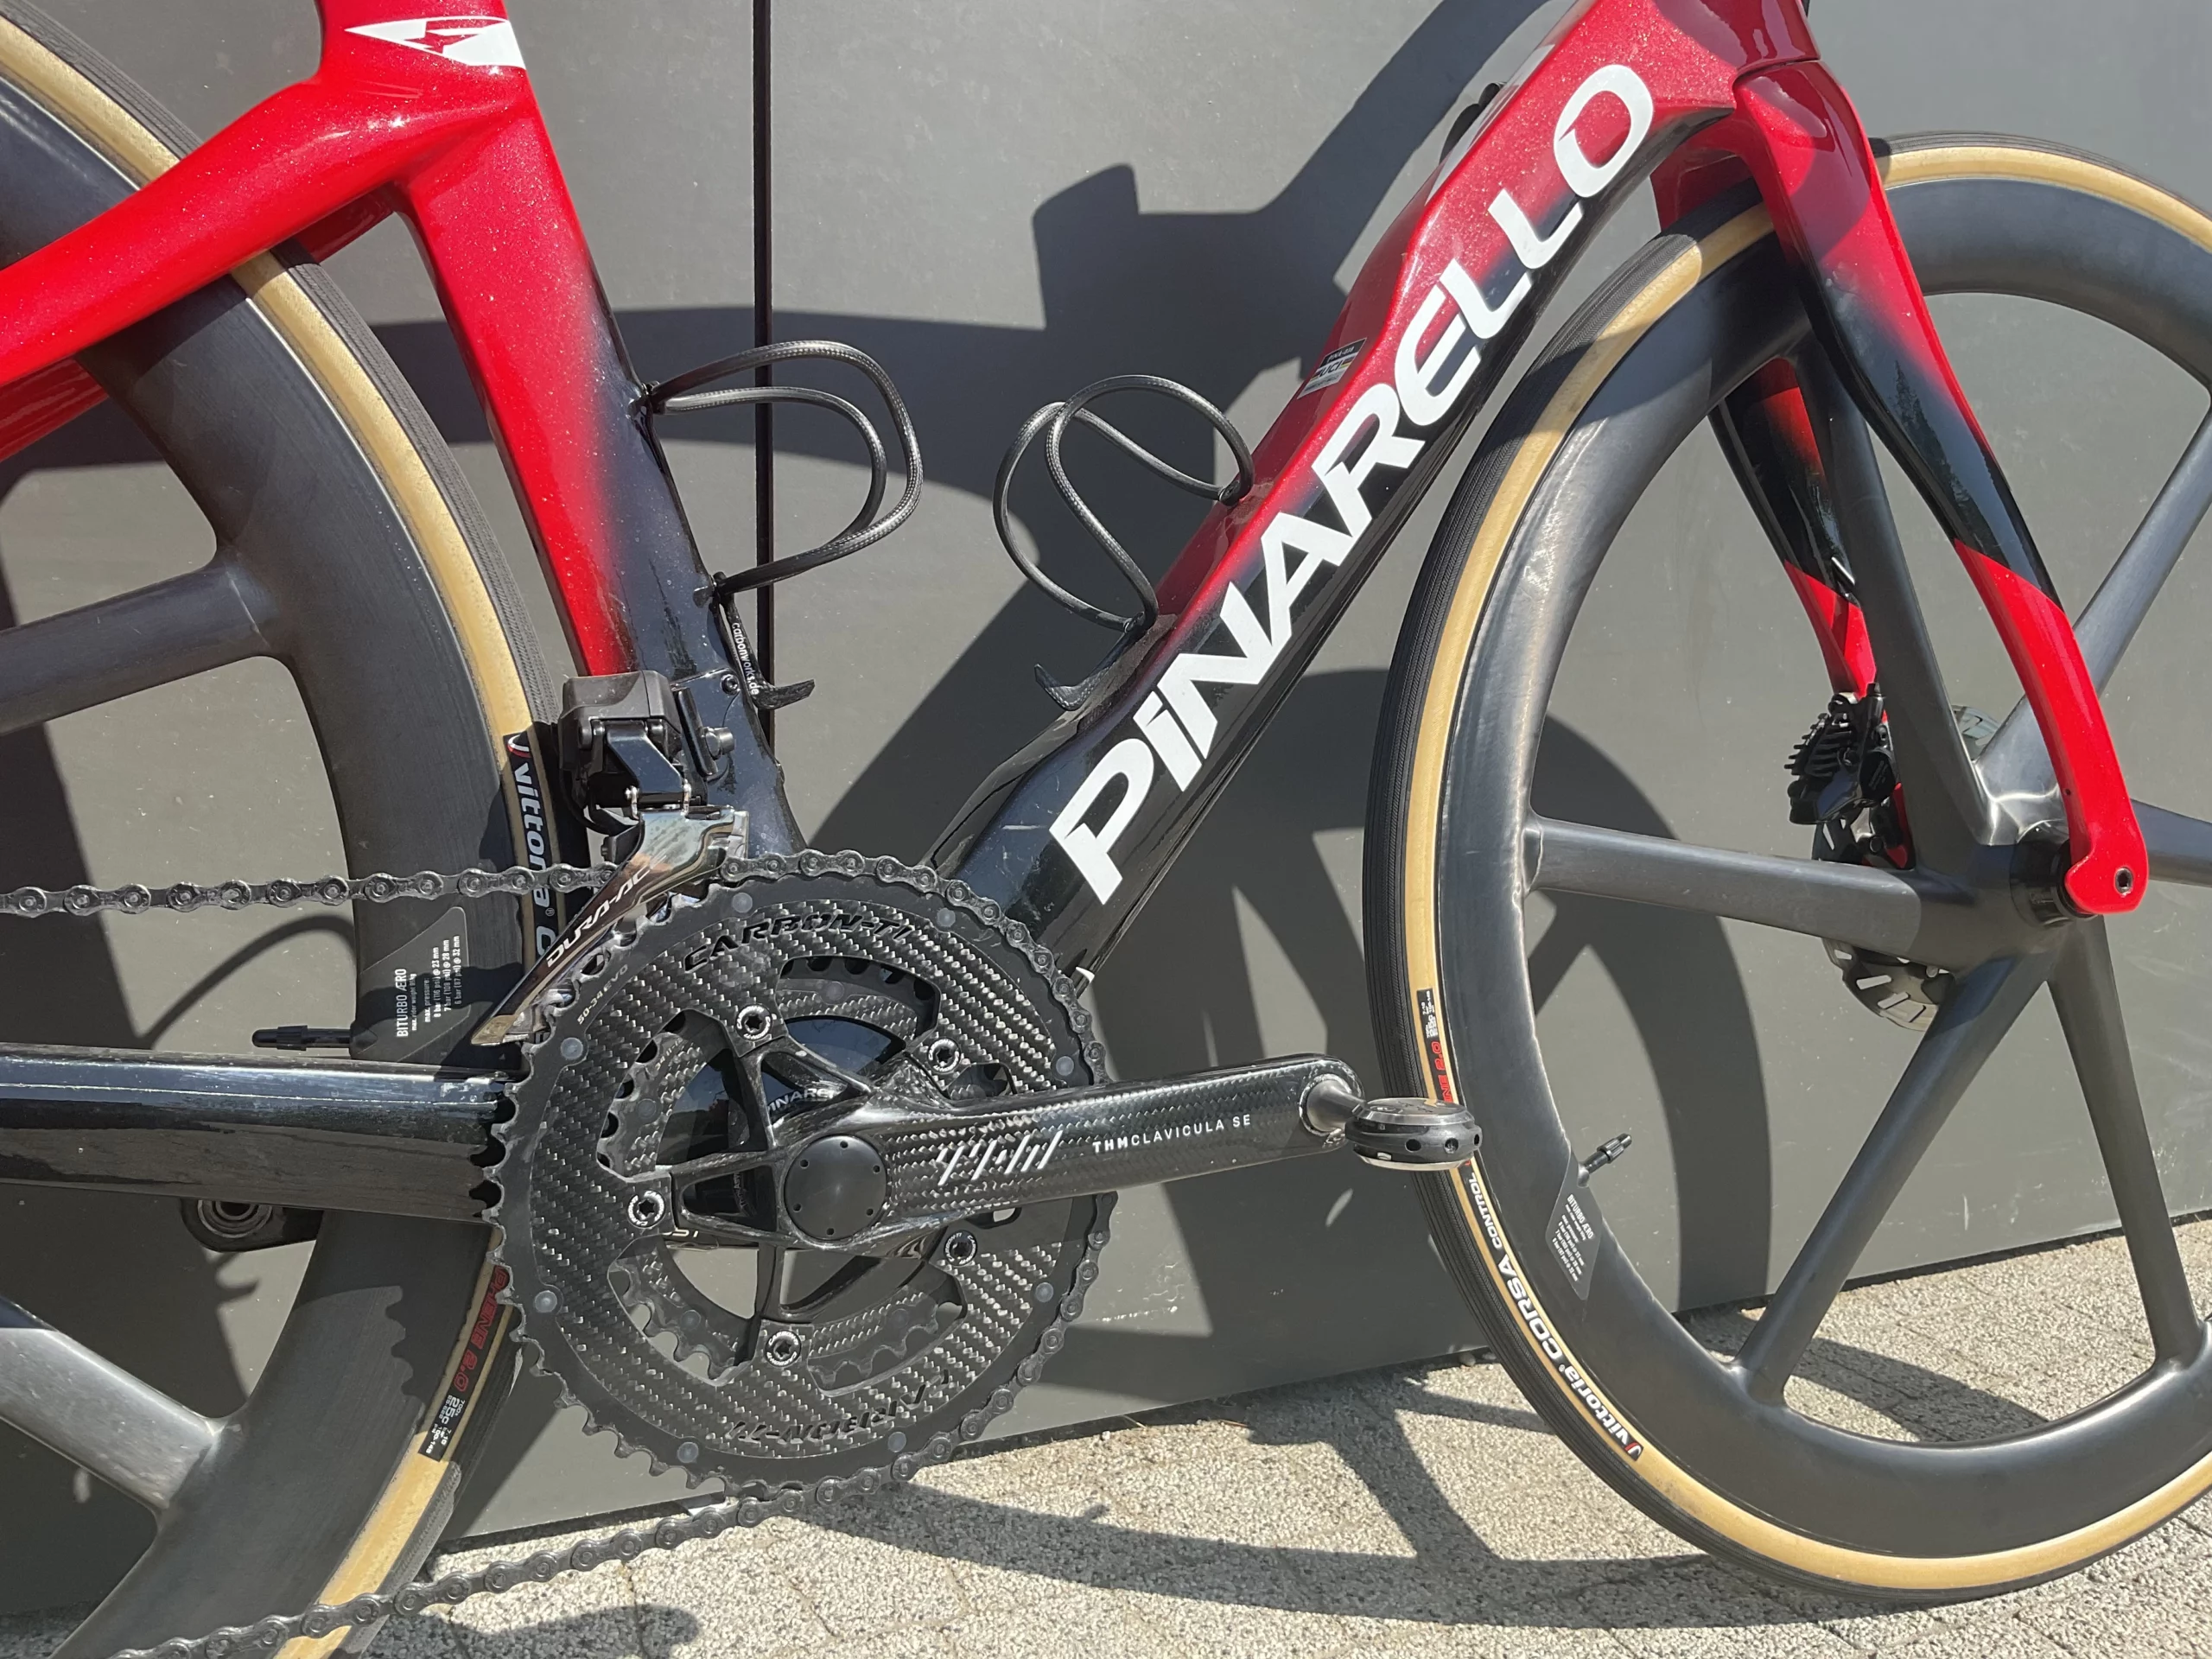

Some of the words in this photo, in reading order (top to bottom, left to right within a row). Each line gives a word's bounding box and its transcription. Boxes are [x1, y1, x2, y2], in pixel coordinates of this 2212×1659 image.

[1319, 360, 1343, 378] UCI
[1048, 63, 1655, 905] PINARELLO
[732, 622, 761, 695] carbonworks.de
[513, 761, 550, 907] vittora
[683, 912, 914, 973] CARBON-TI
[396, 995, 409, 1037] BITURBO
[1431, 1041, 1446, 1071] 2.0
[767, 1089, 834, 1112] INARE
[1233, 1114, 1251, 1128] SE
[1468, 1172, 1503, 1249] CONTROL
[1567, 1194, 1586, 1224] BITURBO
[1498, 1254, 1563, 1359] CORSA
[454, 1350, 478, 1393] 2.0
[442, 1396, 461, 1425] 25c
